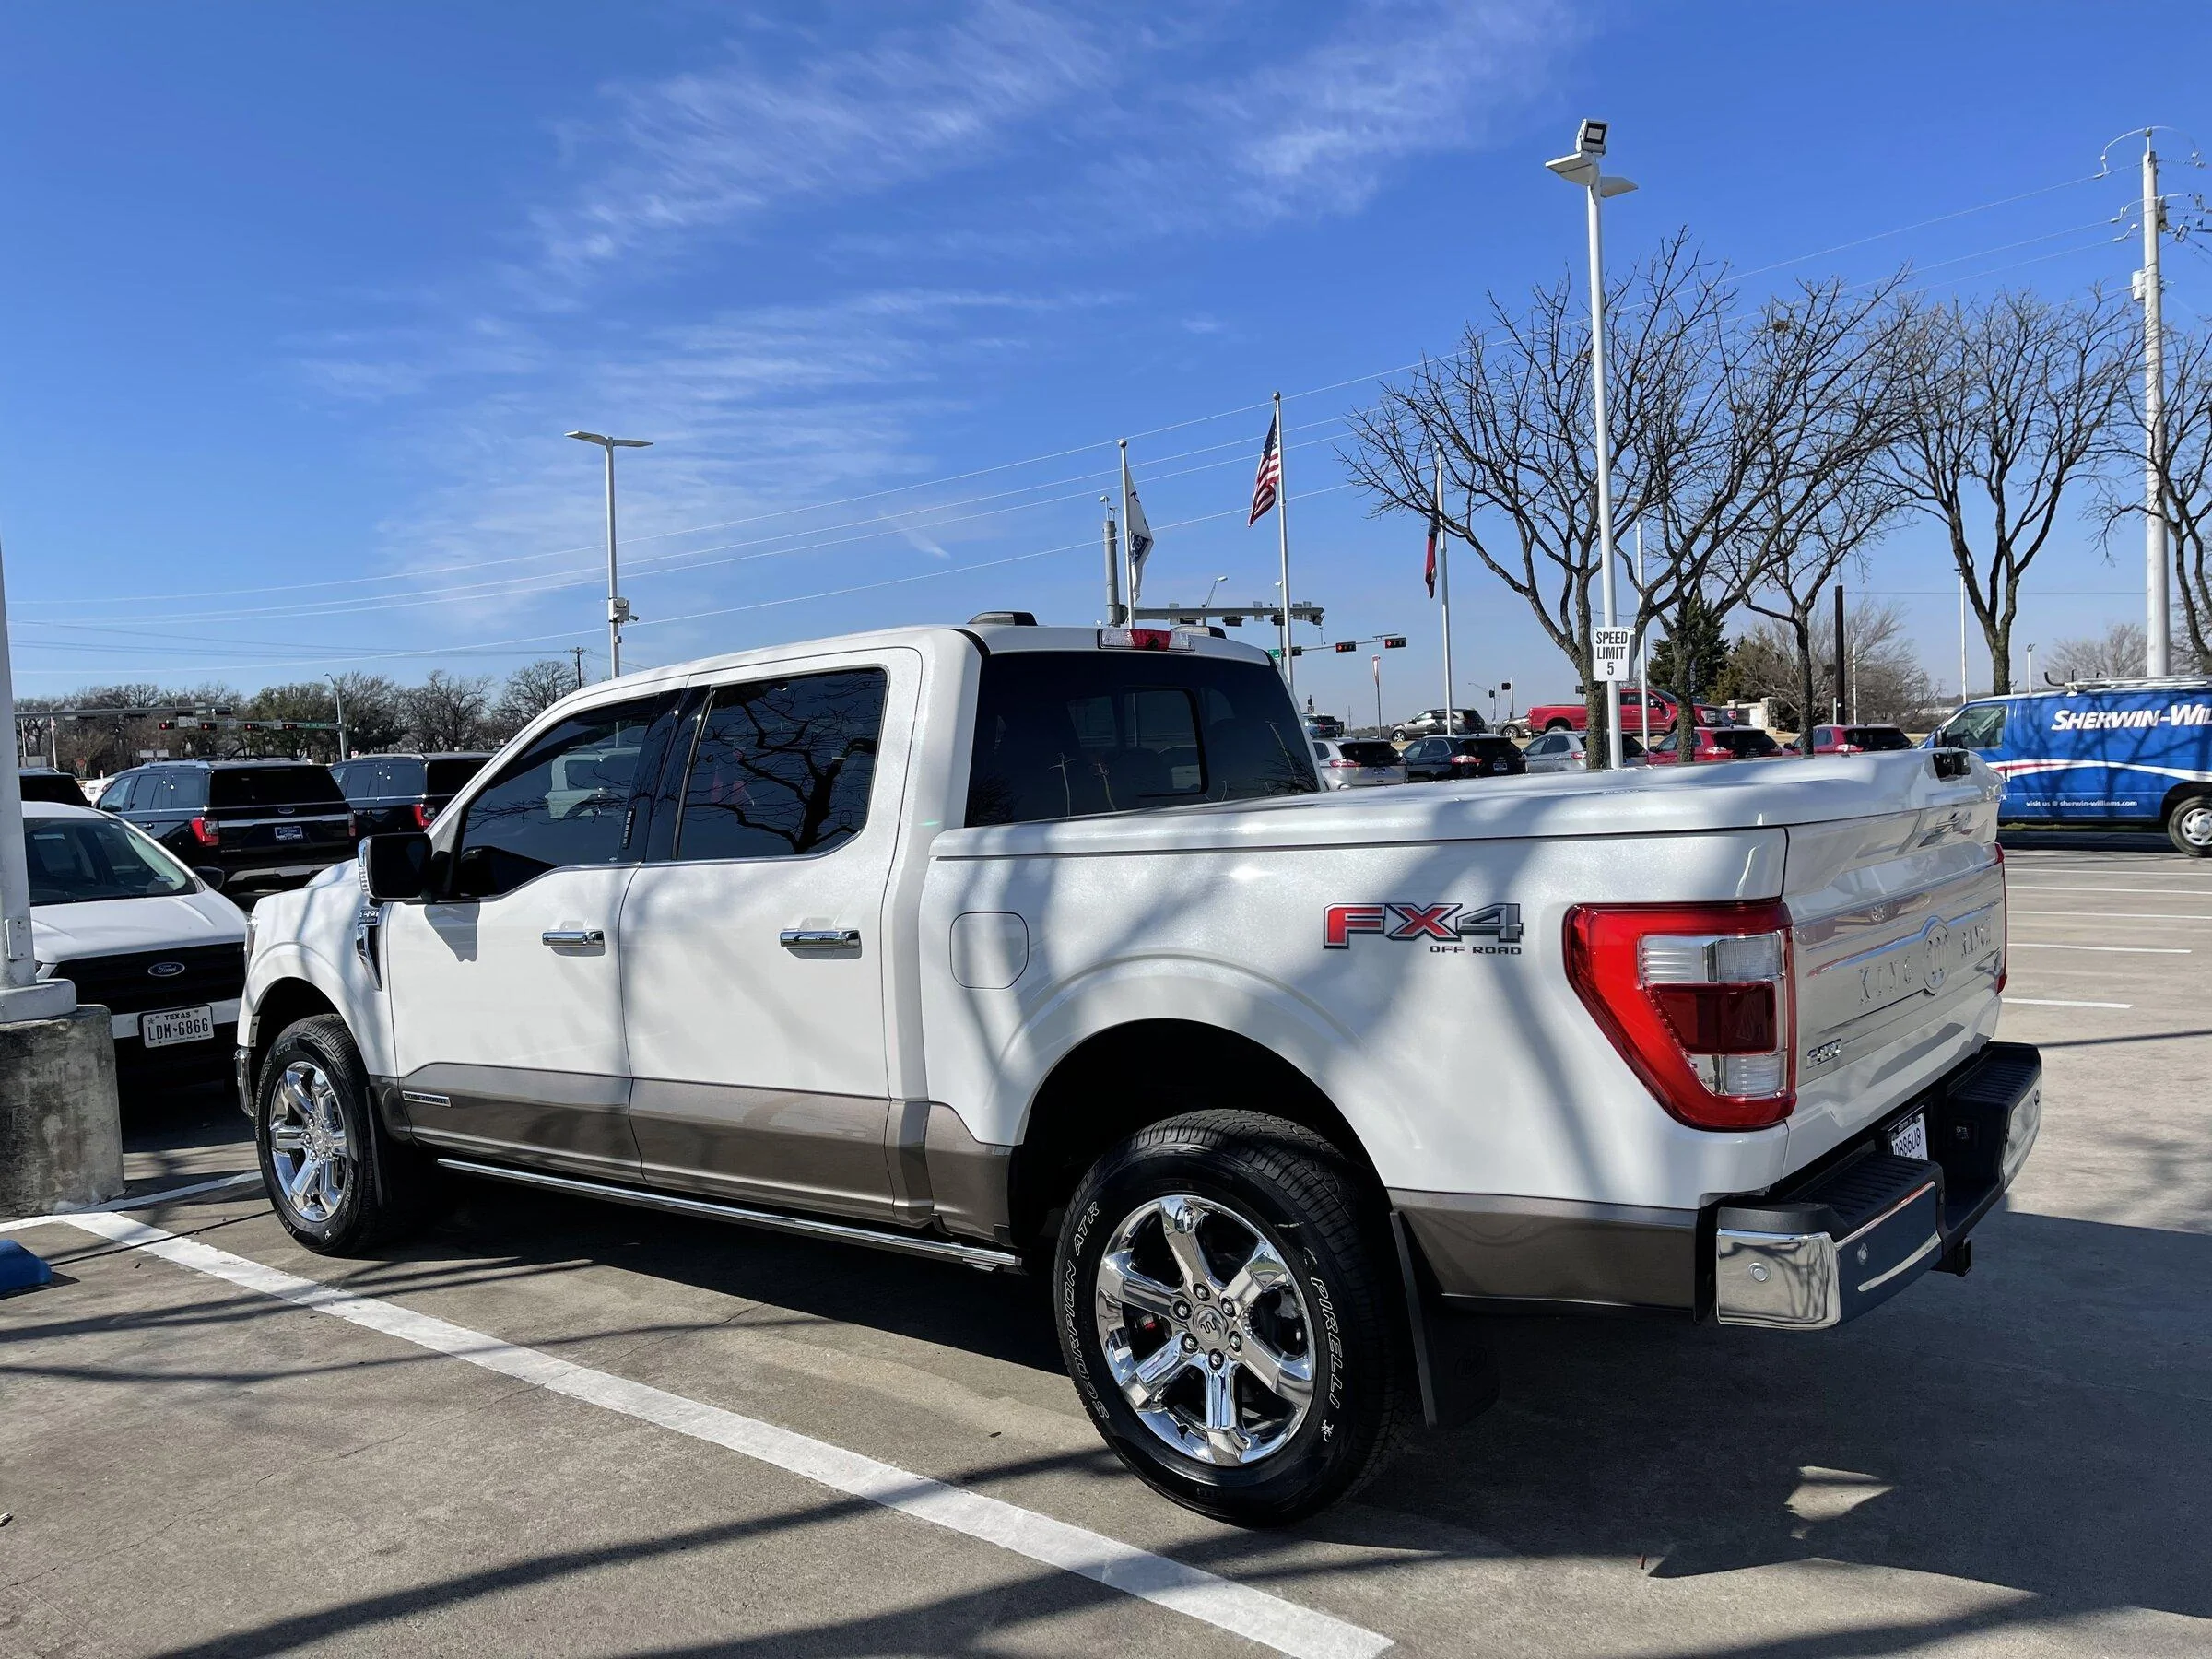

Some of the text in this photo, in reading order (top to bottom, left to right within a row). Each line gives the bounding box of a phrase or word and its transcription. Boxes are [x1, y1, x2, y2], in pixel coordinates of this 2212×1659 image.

[1595, 631, 1628, 644] SPEED
[1596, 646, 1626, 660] LIMIT
[1606, 661, 1615, 676] 5
[2060, 799, 2137, 807] sherwin-williams.com
[1324, 902, 1524, 949] FX4
[1430, 945, 1522, 955] OFF ROAD
[1858, 915, 1992, 1006] KING RANCH
[164, 1011, 191, 1021] TEXAS
[1065, 1201, 1109, 1418] SCORPION ATR
[1310, 1277, 1343, 1409] PIRELLI
